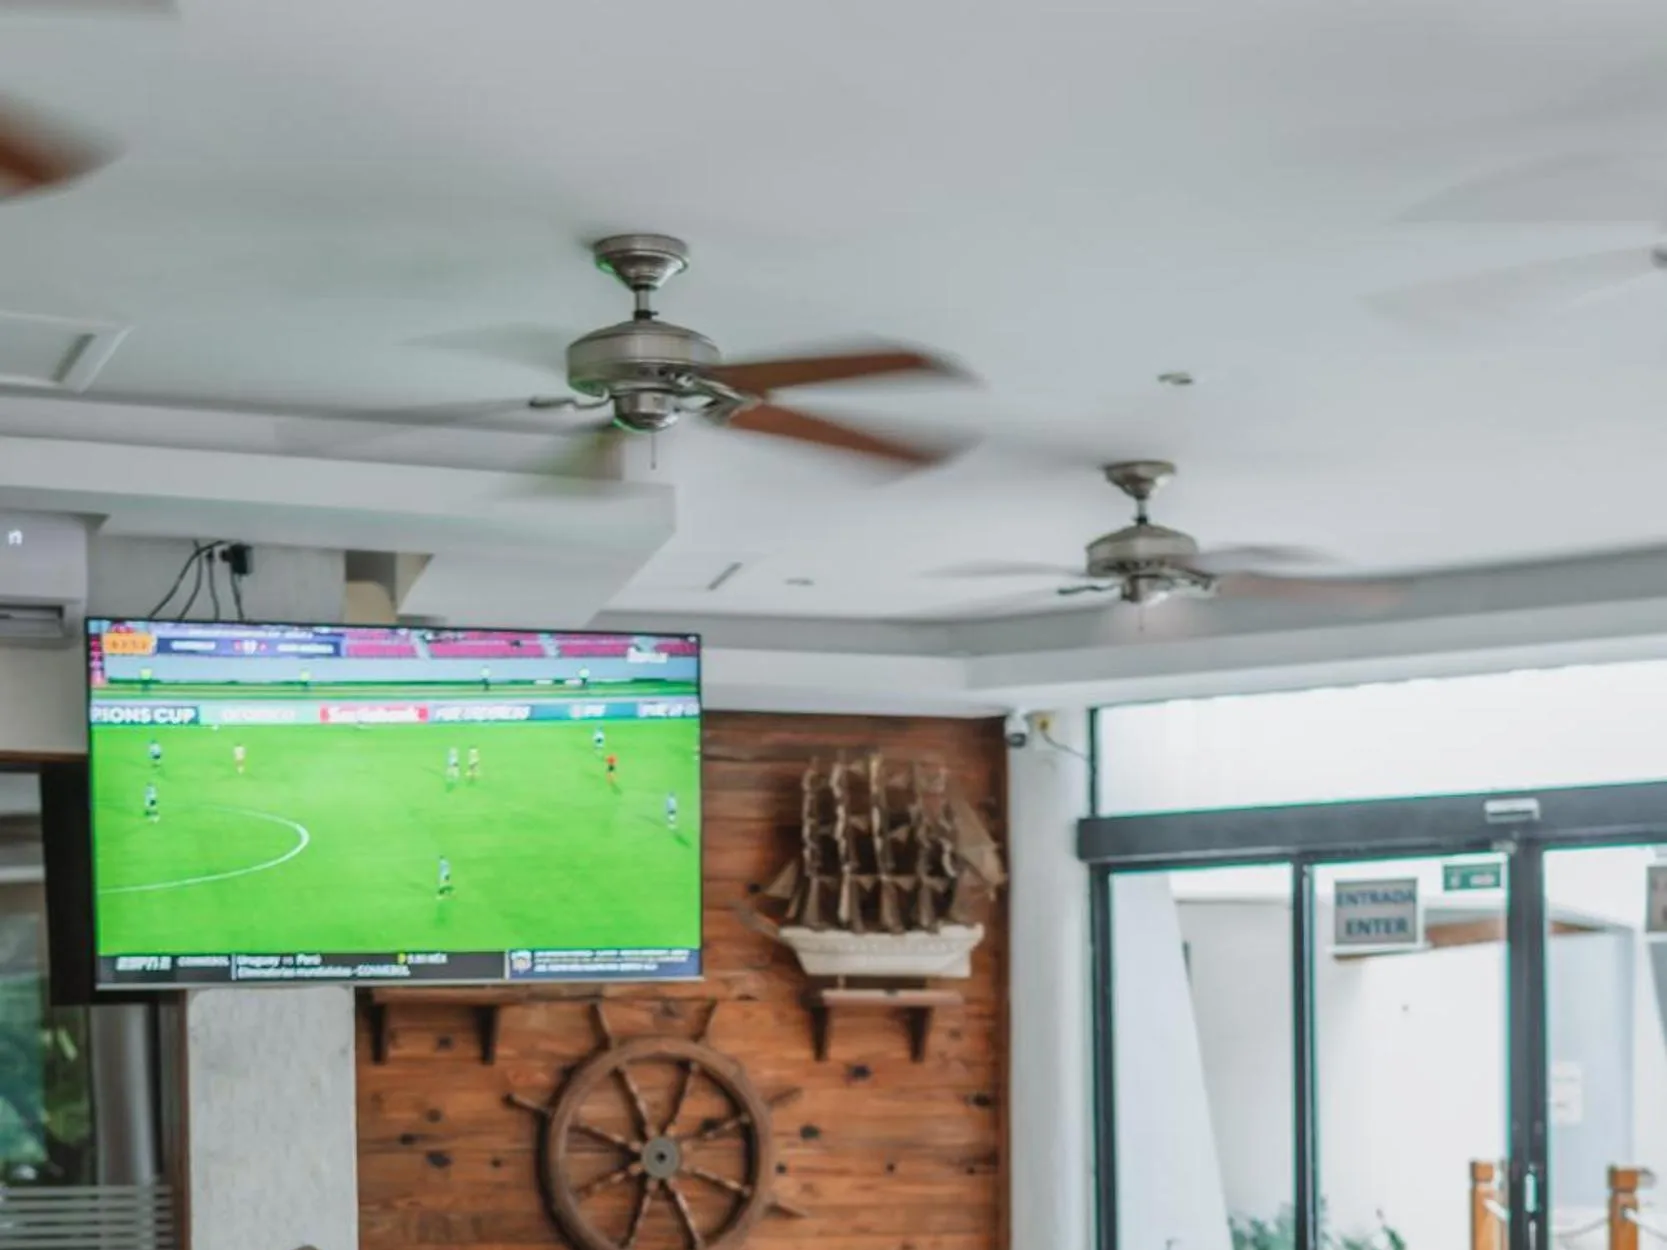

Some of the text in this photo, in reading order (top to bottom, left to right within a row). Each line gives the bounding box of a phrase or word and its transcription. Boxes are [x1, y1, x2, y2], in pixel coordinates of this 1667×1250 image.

[153, 707, 196, 724] CUP
[1336, 889, 1417, 907] ENTRADA
[1345, 916, 1408, 936] ENTER
